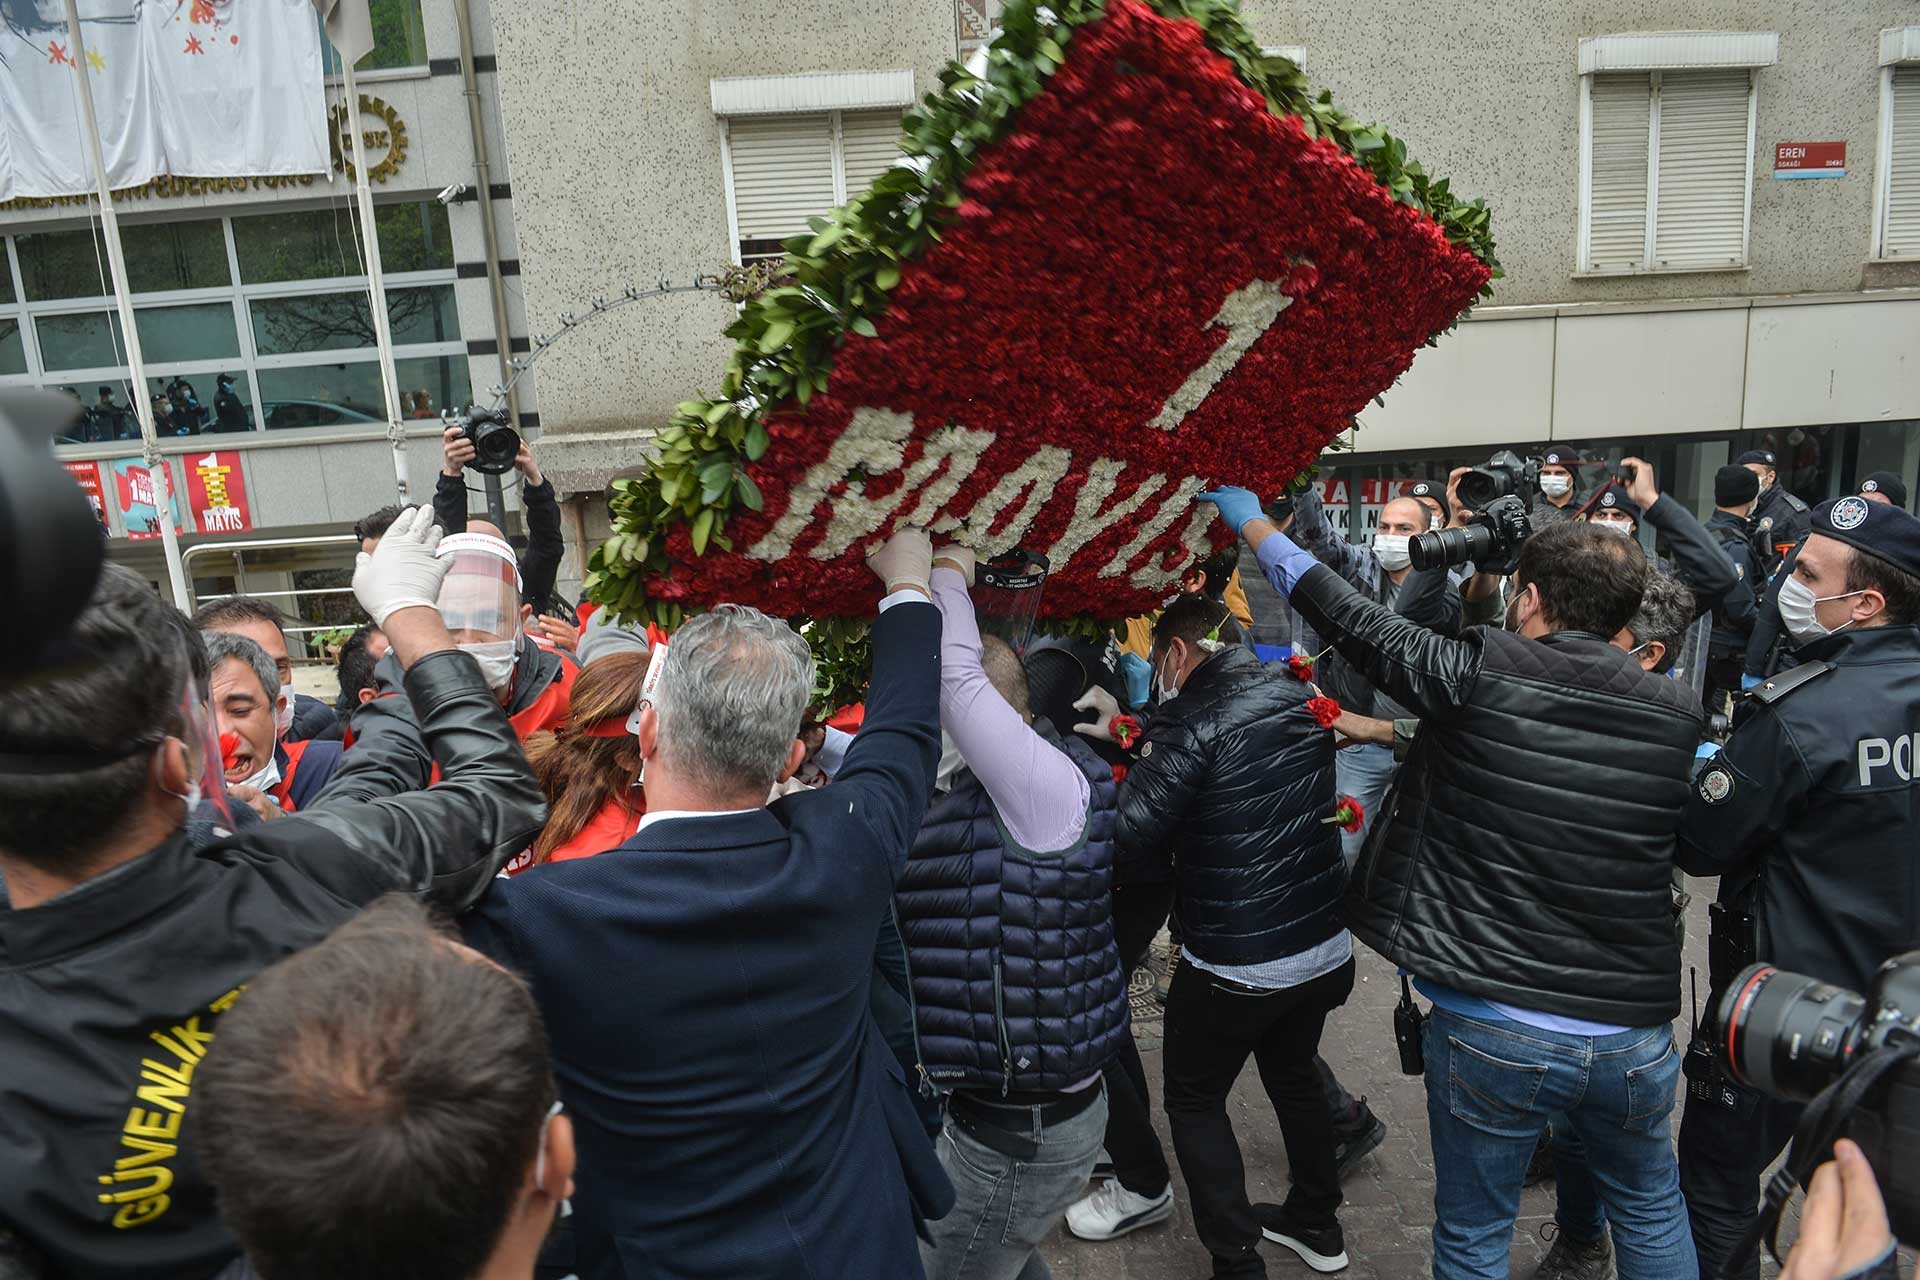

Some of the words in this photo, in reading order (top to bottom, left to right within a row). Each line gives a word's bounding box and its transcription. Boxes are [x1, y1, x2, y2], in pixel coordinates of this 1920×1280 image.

[1779, 147, 1806, 159] EREN
[1147, 277, 1293, 431] 1
[203, 507, 243, 532] MAYIS
[1858, 732, 1920, 787] PO
